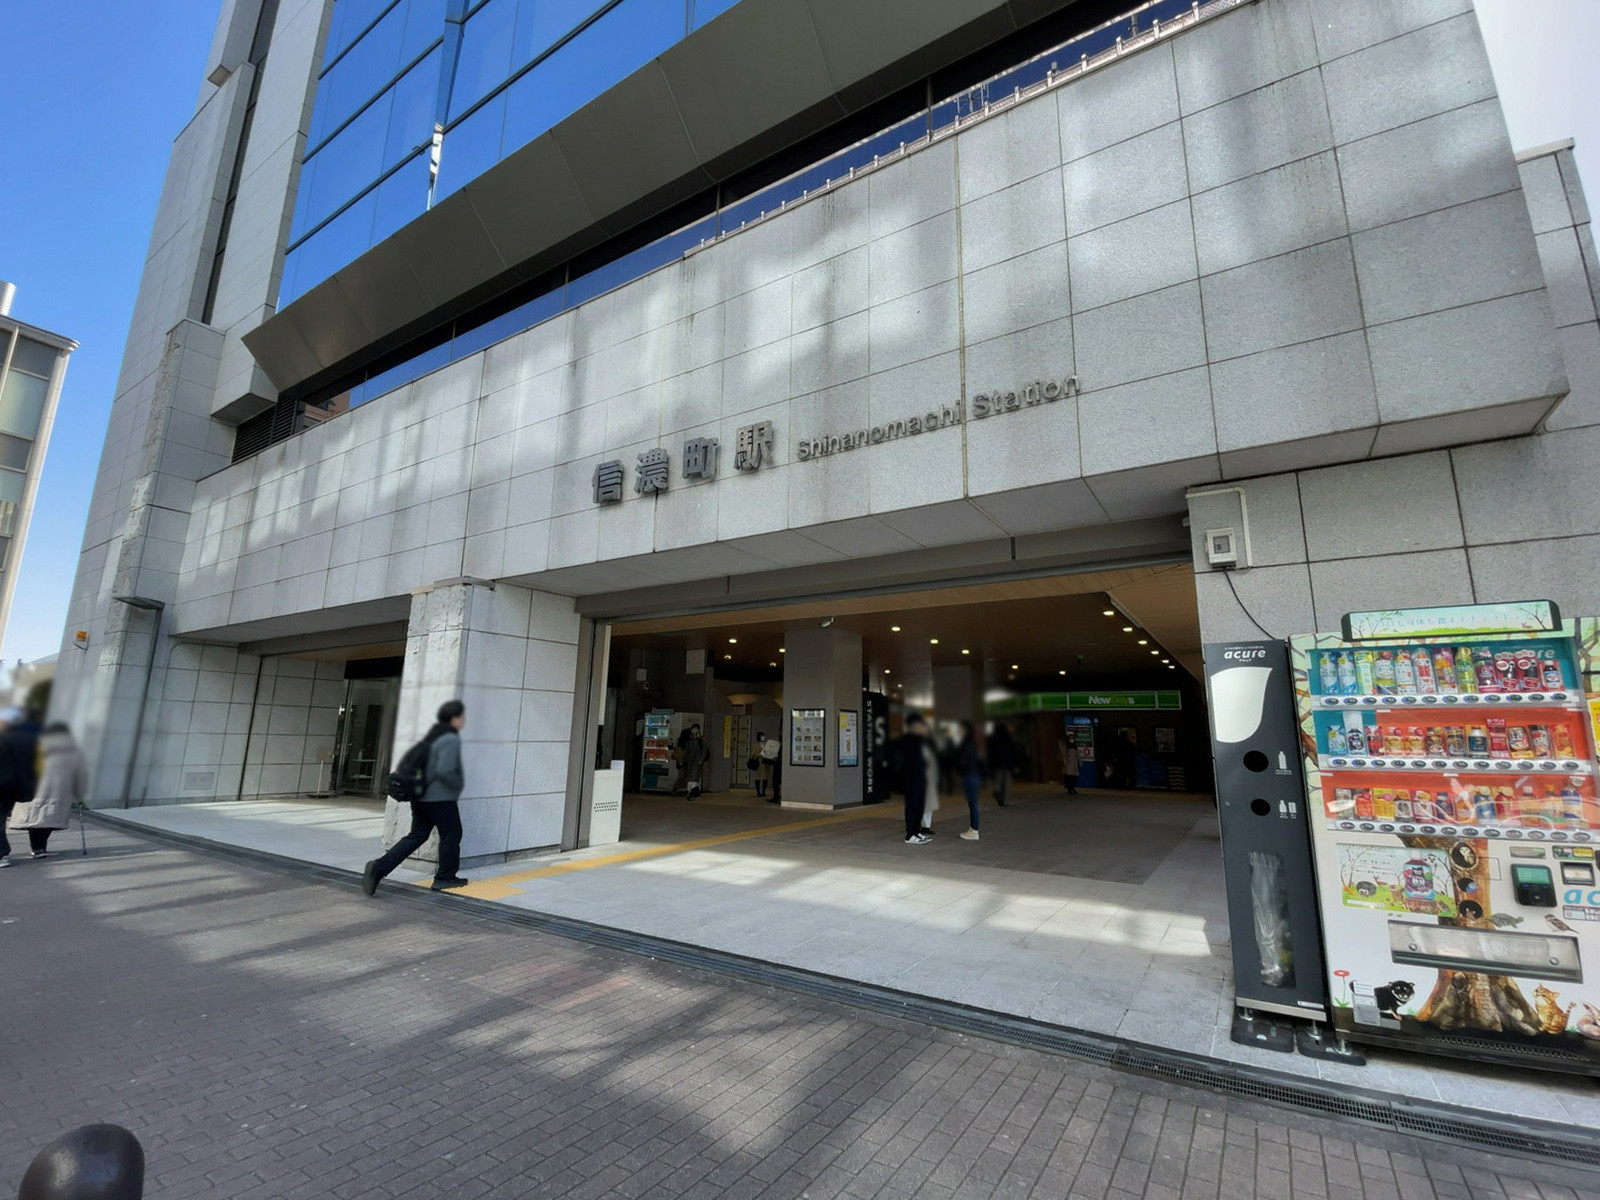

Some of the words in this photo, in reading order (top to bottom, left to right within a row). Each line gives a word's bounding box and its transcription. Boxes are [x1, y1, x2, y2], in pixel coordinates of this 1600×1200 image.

[797, 399, 963, 461] Shinanomachi
[972, 374, 1079, 419] Station
[592, 420, 773, 504] 信濃町駅
[1223, 650, 1267, 659] acure
[866, 756, 874, 794] WORK
